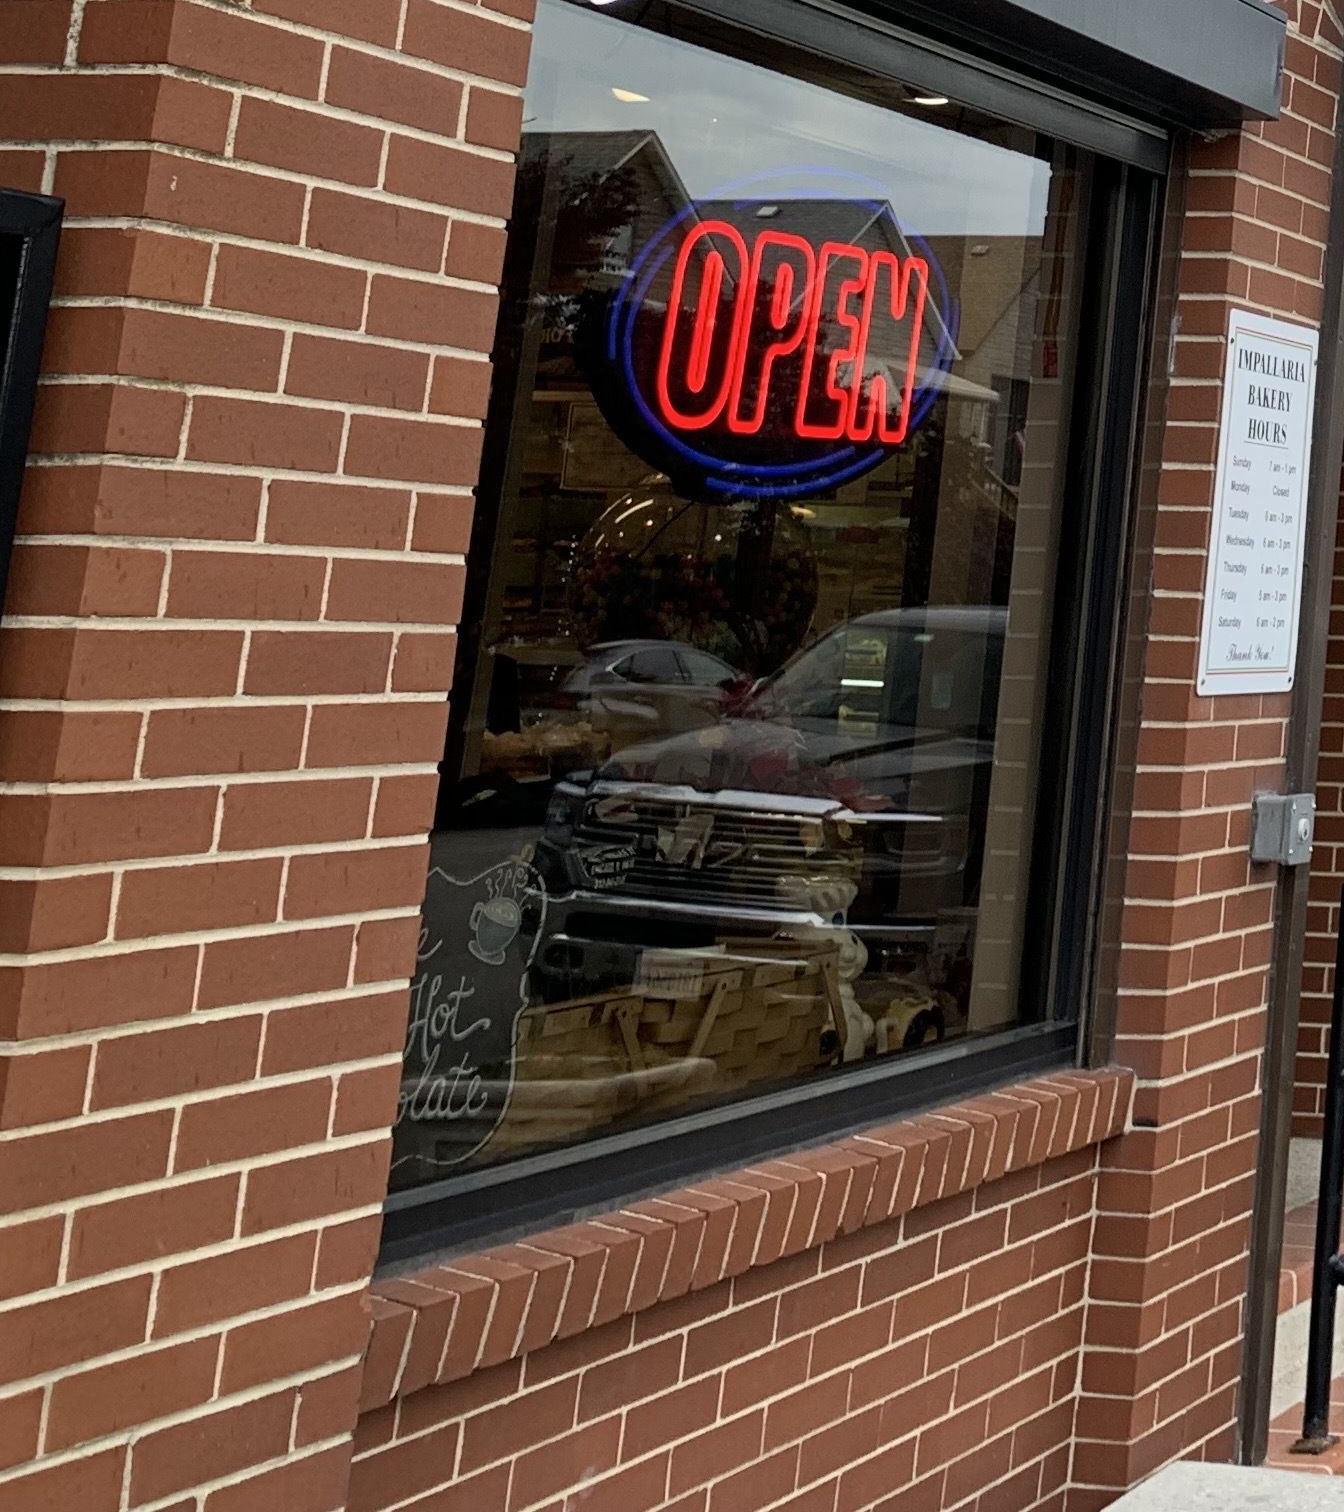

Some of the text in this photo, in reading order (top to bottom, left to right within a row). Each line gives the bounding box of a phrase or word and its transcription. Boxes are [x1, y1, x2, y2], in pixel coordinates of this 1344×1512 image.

[656, 220, 929, 443] OPEN
[1238, 348, 1305, 383] IMPALLARIA
[1248, 384, 1293, 412] BAKERY
[1248, 418, 1287, 445] HOURS
[1233, 455, 1251, 471] Sunday
[1231, 480, 1289, 497] Monday Closed
[1229, 506, 1248, 522] Tuesday
[1226, 535, 1254, 549] Wednesday
[1224, 561, 1247, 576] Thursday
[1220, 588, 1237, 603] Friday
[1218, 616, 1241, 631] Saturday
[1226, 643, 1252, 661] Thank
[403, 972, 491, 1063] Hot
